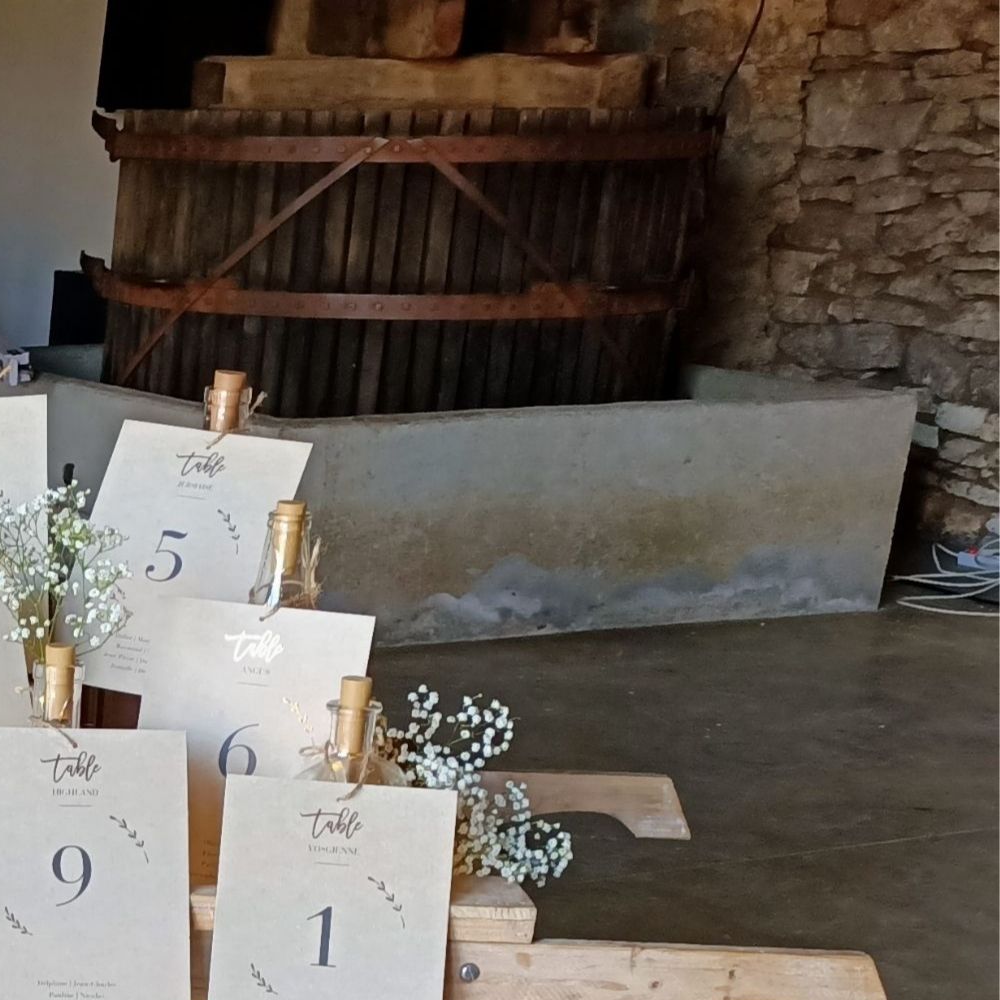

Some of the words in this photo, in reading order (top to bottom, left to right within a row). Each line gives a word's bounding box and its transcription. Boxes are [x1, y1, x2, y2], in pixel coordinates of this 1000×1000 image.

[176, 452, 225, 478] table
[145, 530, 188, 582] 5
[224, 630, 284, 663] table
[218, 723, 259, 777] 6
[40, 751, 102, 783] table
[52, 788, 100, 797] HIGHLAND
[300, 807, 363, 839] table
[51, 845, 92, 907] 9
[306, 906, 336, 968] 1
